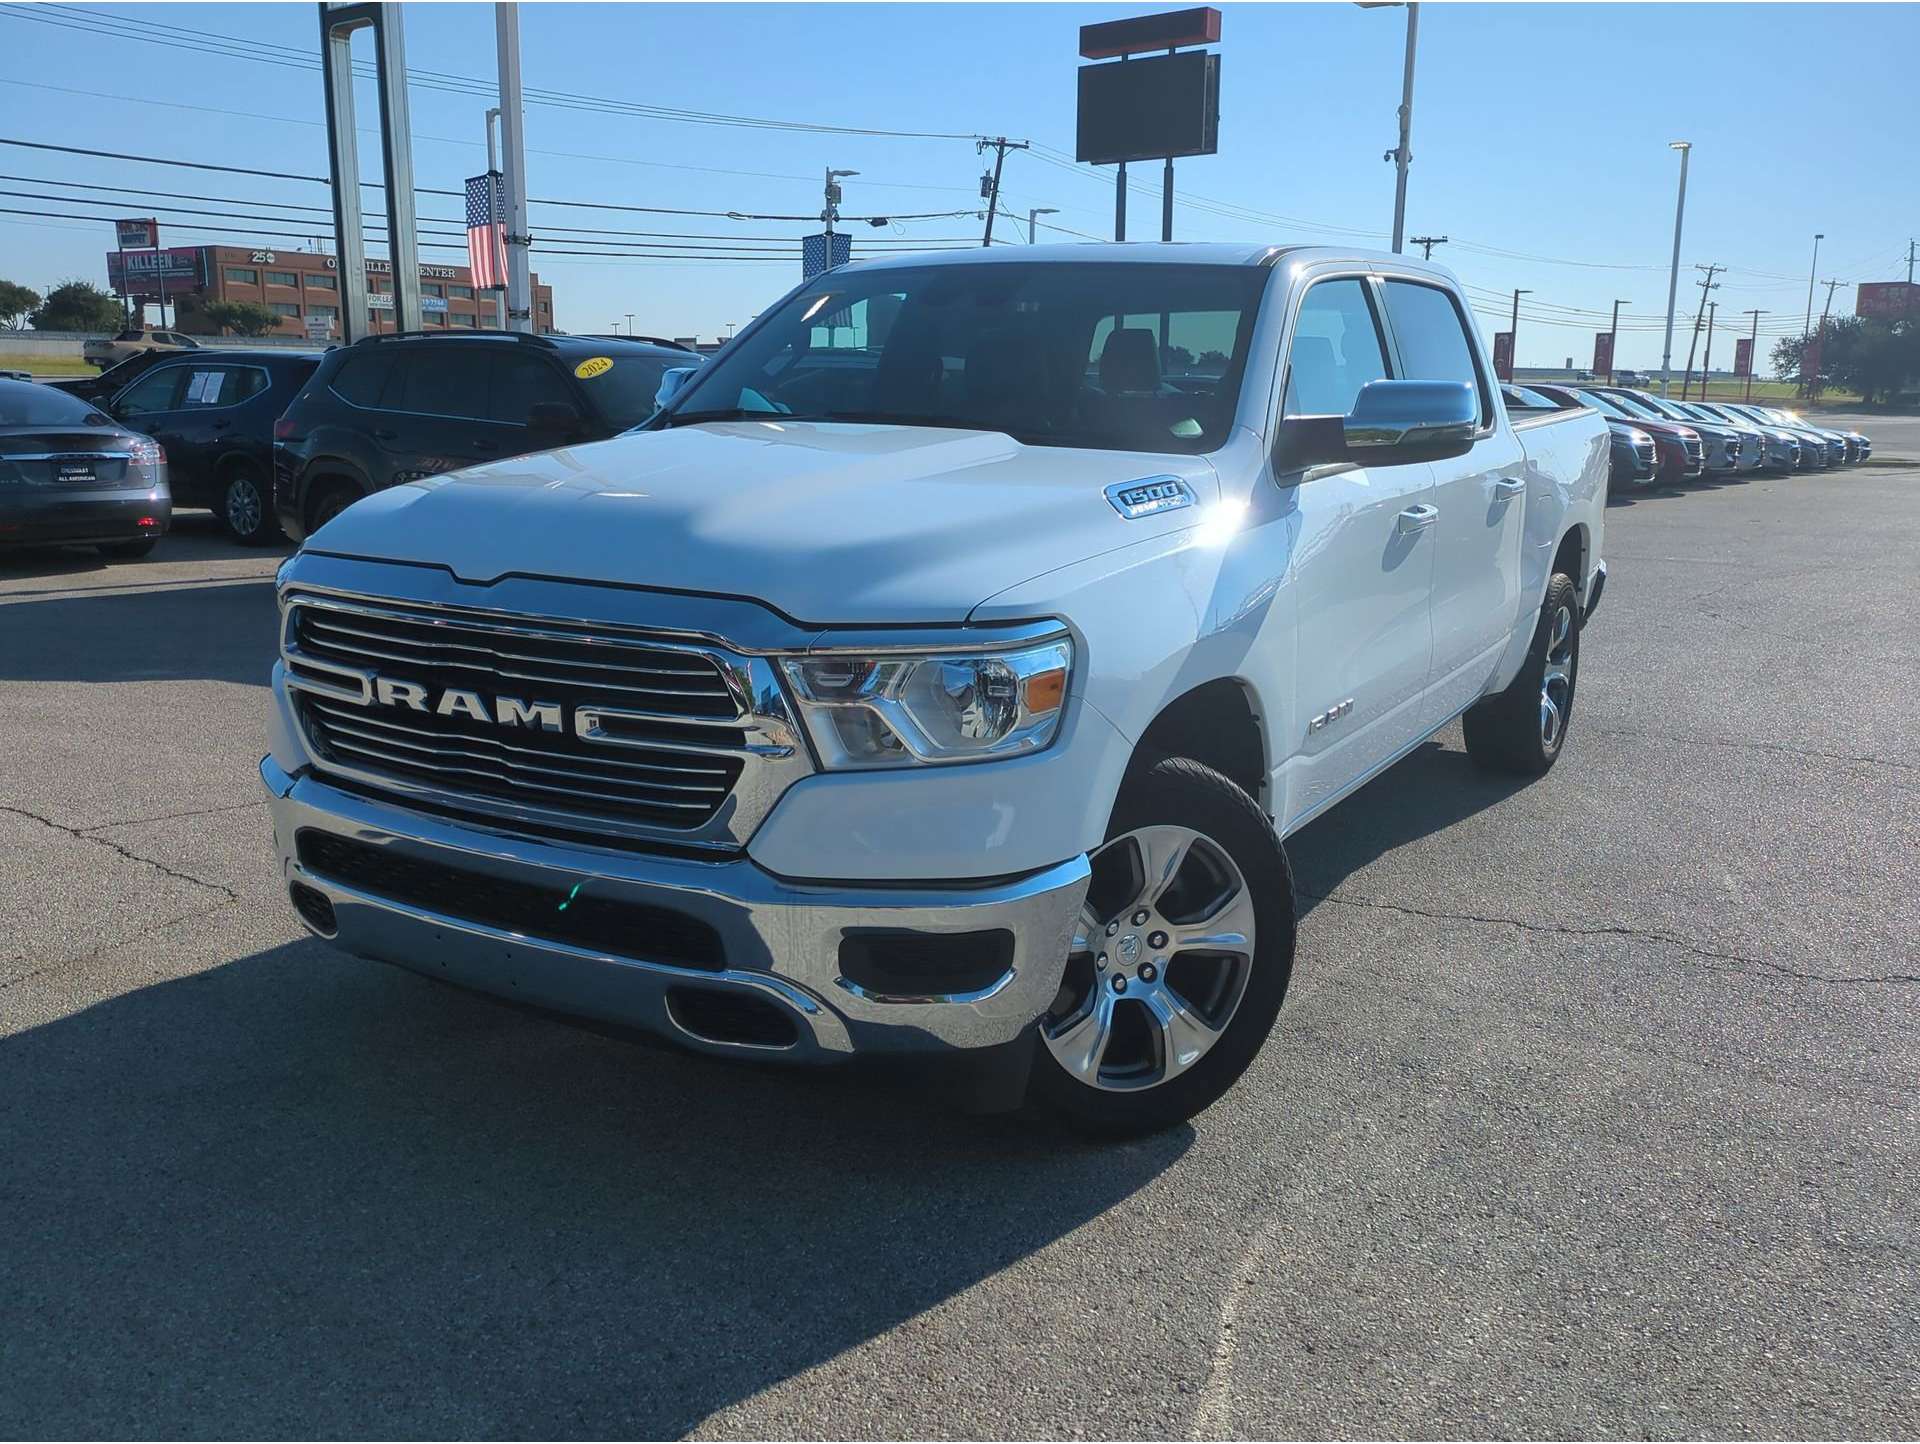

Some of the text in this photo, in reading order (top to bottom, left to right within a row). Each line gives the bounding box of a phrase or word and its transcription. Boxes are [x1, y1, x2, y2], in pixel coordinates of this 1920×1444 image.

[127, 253, 173, 270] KILLEEN
[366, 261, 456, 278] ILLE ENTER
[582, 359, 609, 377] 2024
[1120, 482, 1180, 506] 1500
[376, 677, 563, 734] RAM
[1308, 698, 1354, 736] RAM
